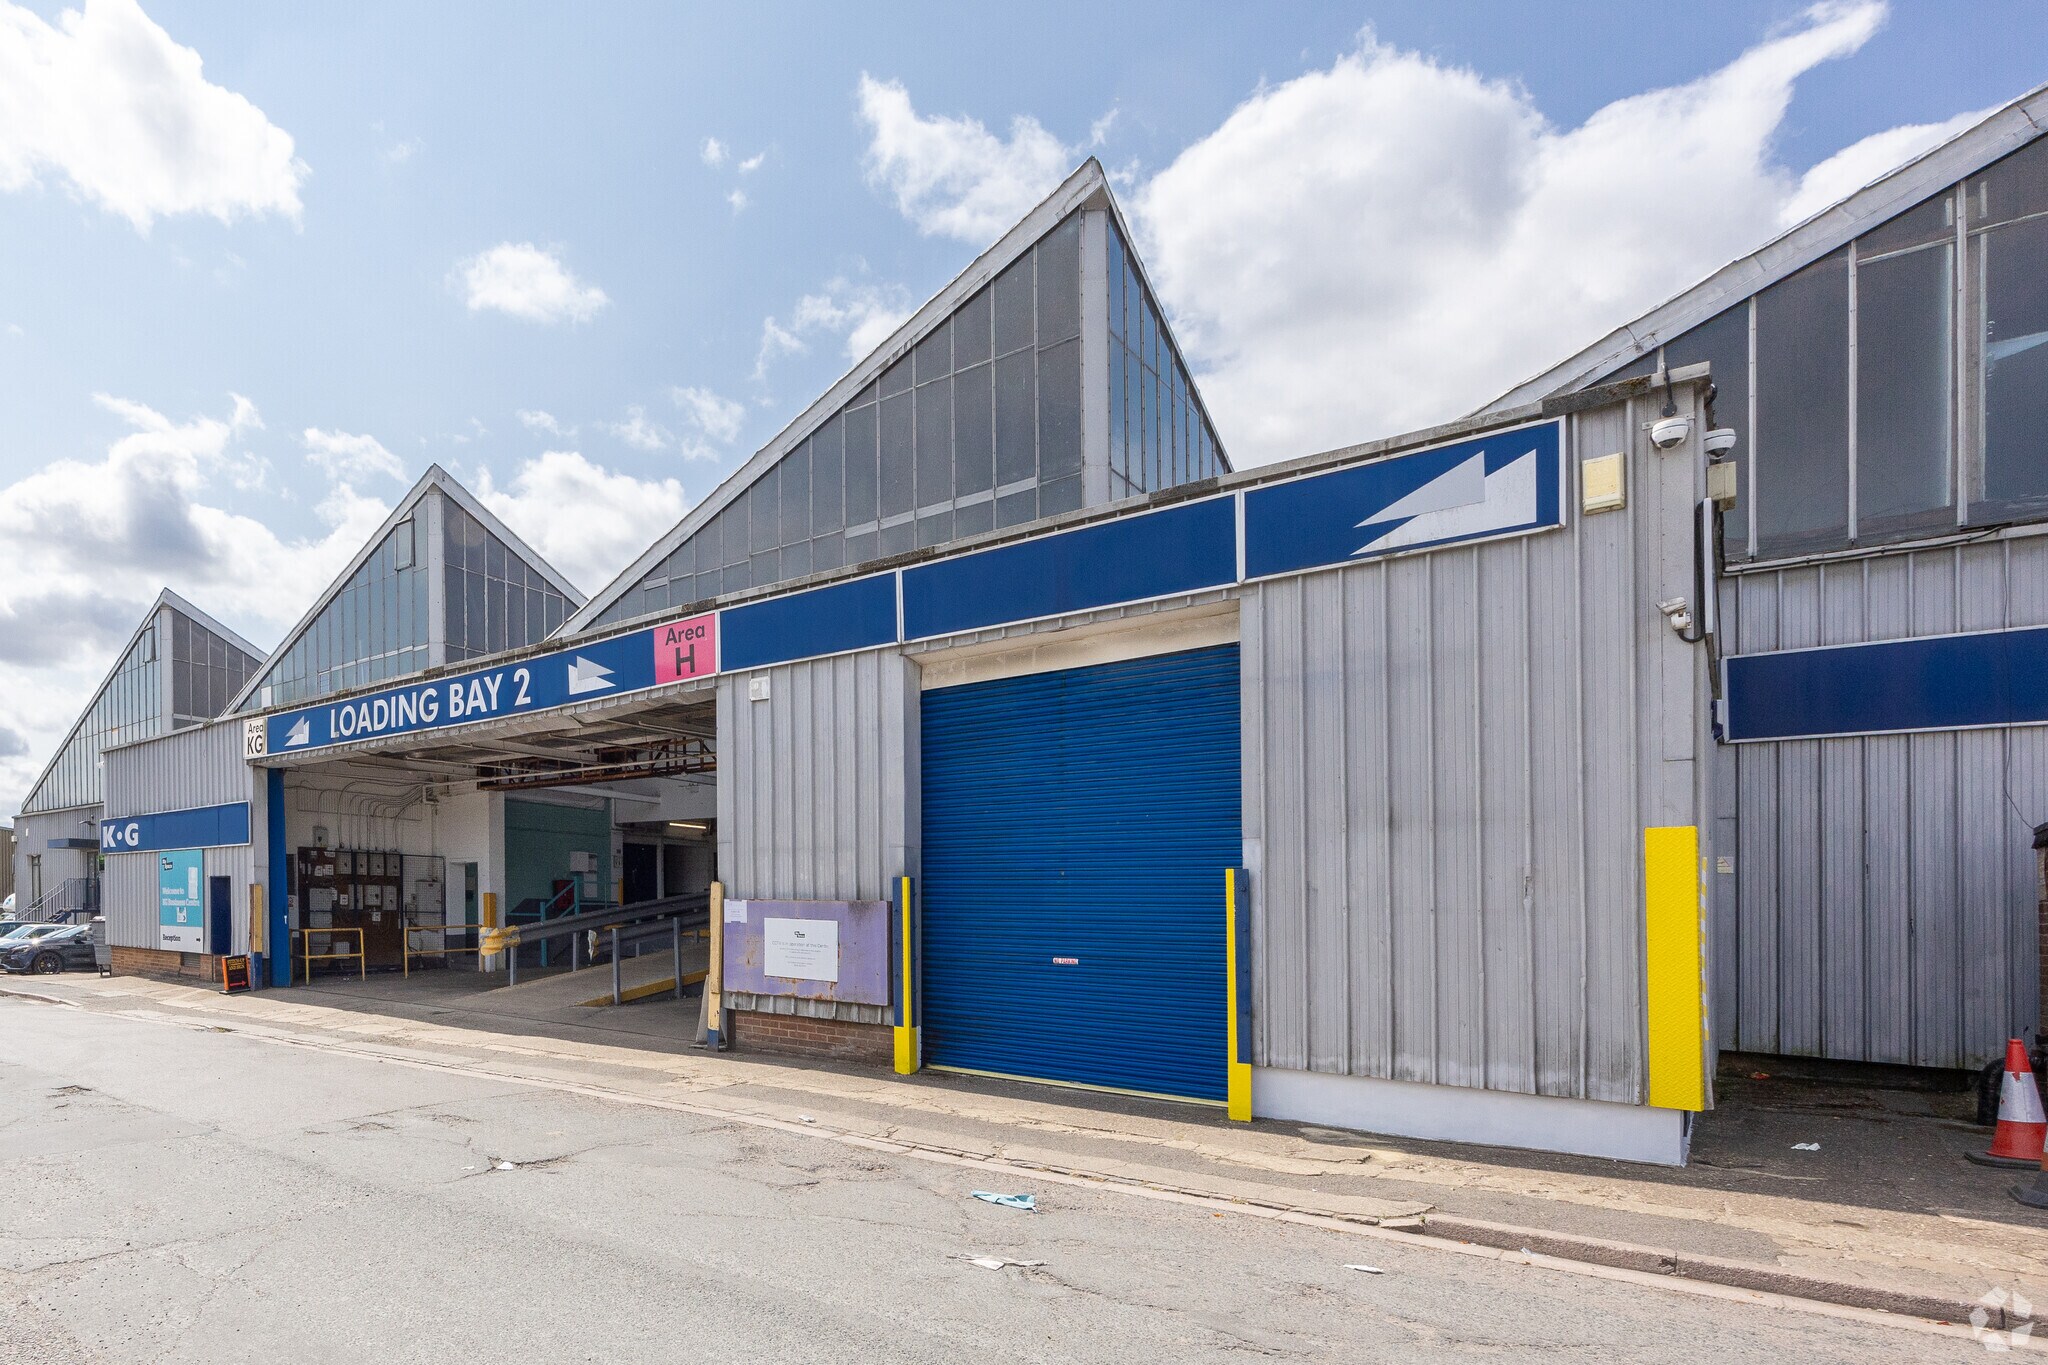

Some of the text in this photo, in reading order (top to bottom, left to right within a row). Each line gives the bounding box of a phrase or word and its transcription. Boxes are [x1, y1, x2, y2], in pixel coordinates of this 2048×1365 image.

[665, 625, 705, 646] Area
[675, 643, 695, 677] H
[330, 668, 531, 739] LOADING BAY 2
[248, 723, 264, 734] Area
[247, 735, 263, 755] KG
[162, 933, 181, 943] Reception
